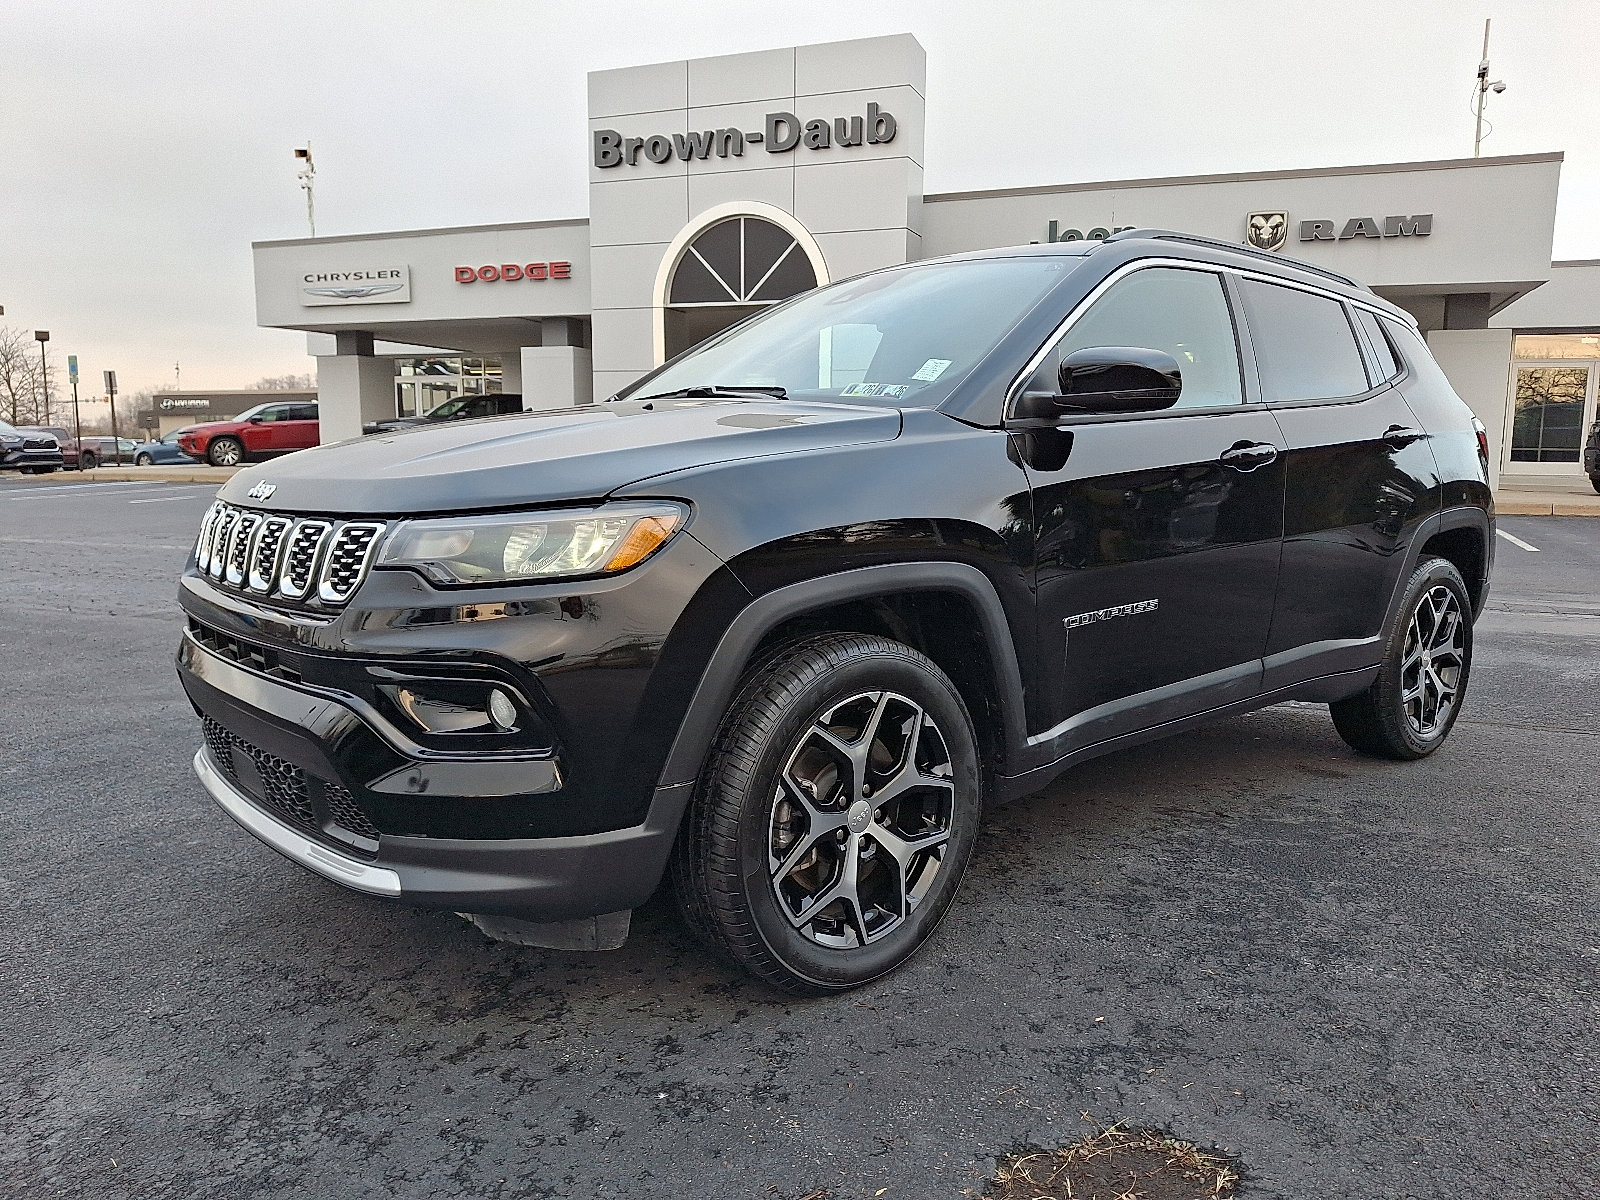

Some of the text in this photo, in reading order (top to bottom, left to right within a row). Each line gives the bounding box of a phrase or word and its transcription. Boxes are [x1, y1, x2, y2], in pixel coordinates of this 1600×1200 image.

[593, 101, 897, 168] Brown-Daub
[1029, 219, 1138, 245] Jee
[1299, 213, 1433, 241] RAM
[303, 269, 401, 283] CHRYSLER
[454, 261, 571, 283] DODGE
[1062, 598, 1159, 629] COMPASS
